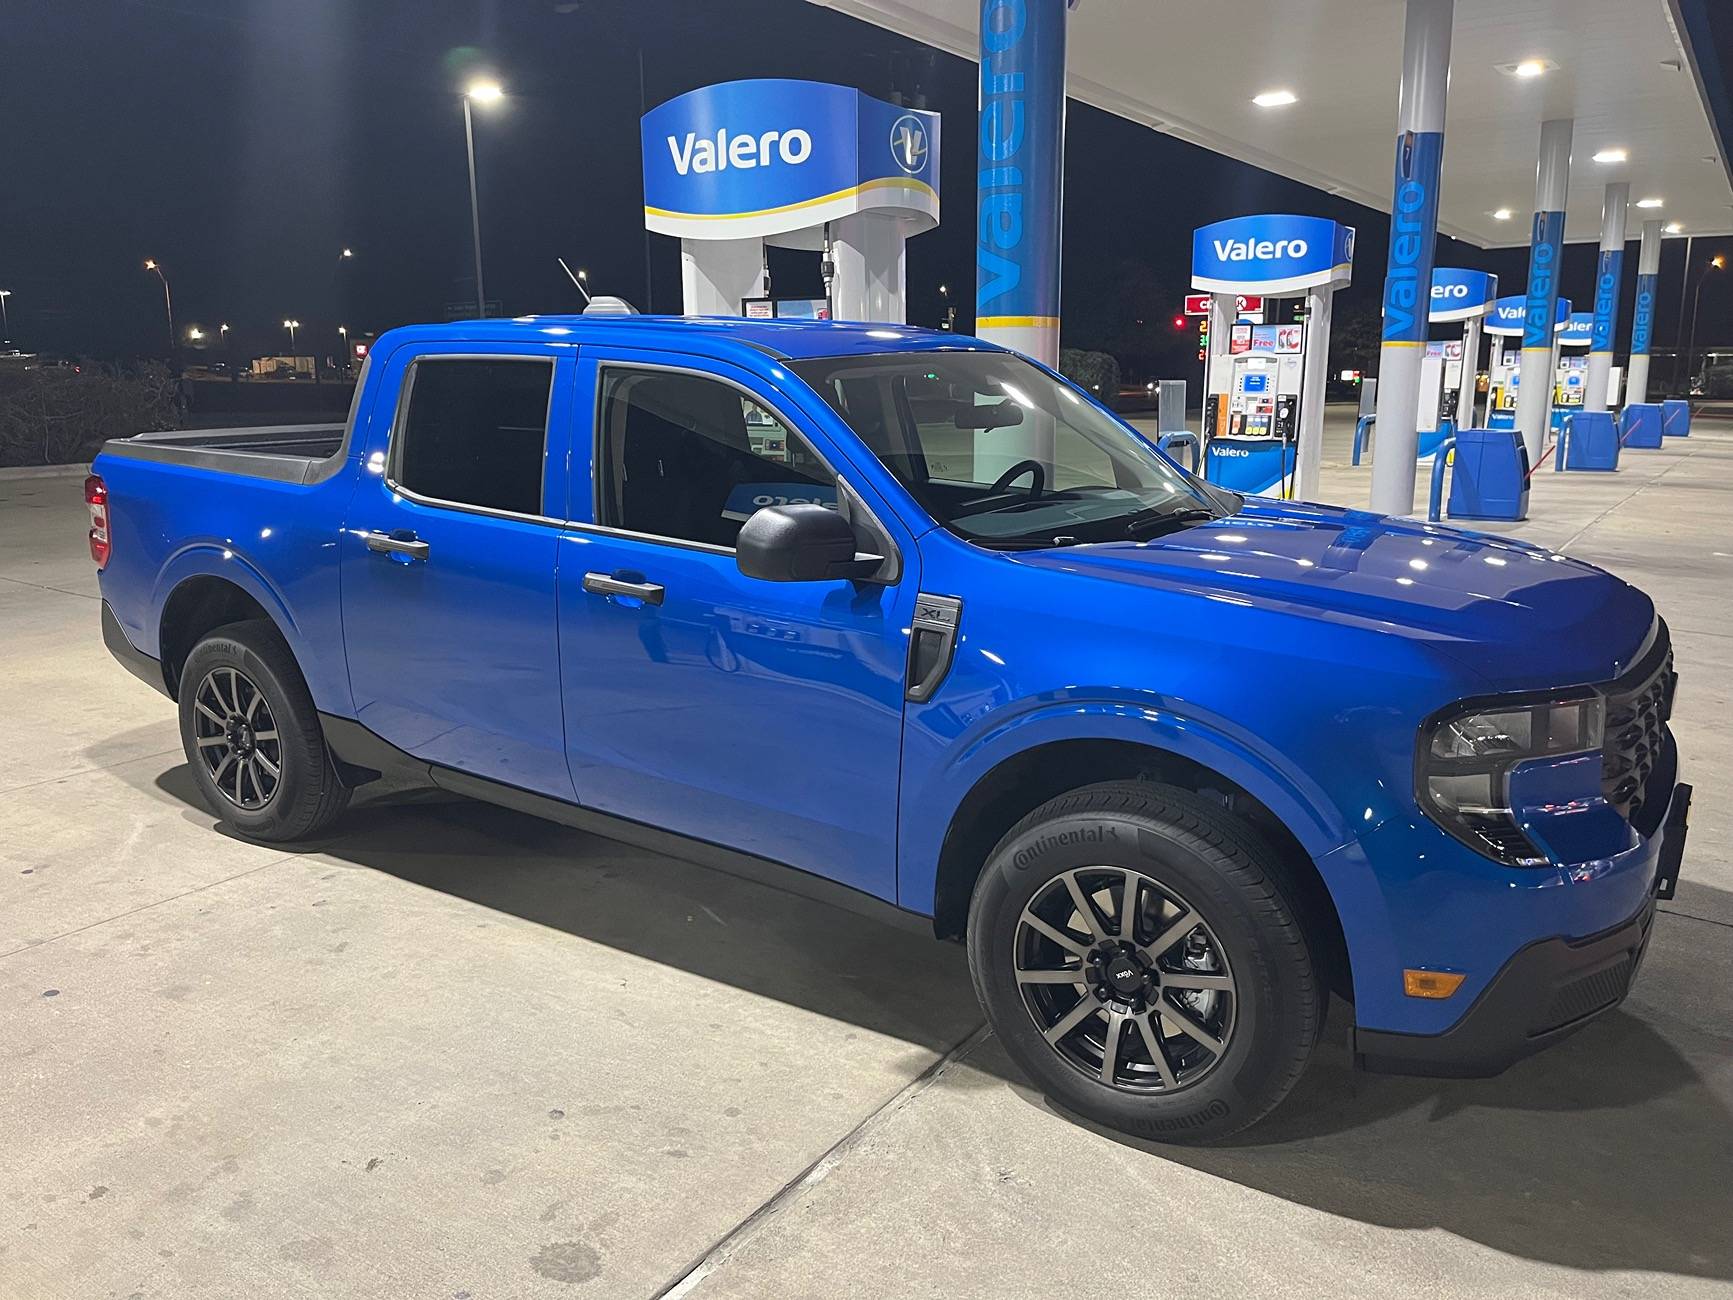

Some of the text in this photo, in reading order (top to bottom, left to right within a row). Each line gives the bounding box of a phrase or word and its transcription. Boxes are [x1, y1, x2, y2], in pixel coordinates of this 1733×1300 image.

[667, 128, 812, 176] Valero
[976, 0, 1027, 309] Valero
[1213, 237, 1308, 262] Valero
[1383, 180, 1425, 340] Valero
[1430, 284, 1468, 298] ero
[1523, 242, 1554, 347] Valero
[1591, 273, 1615, 351] Valero
[1253, 338, 1274, 348] Free
[1631, 292, 1652, 353] Valero
[1211, 446, 1249, 458] Valero
[920, 607, 951, 622] XL
[1013, 826, 1103, 871] Continental
